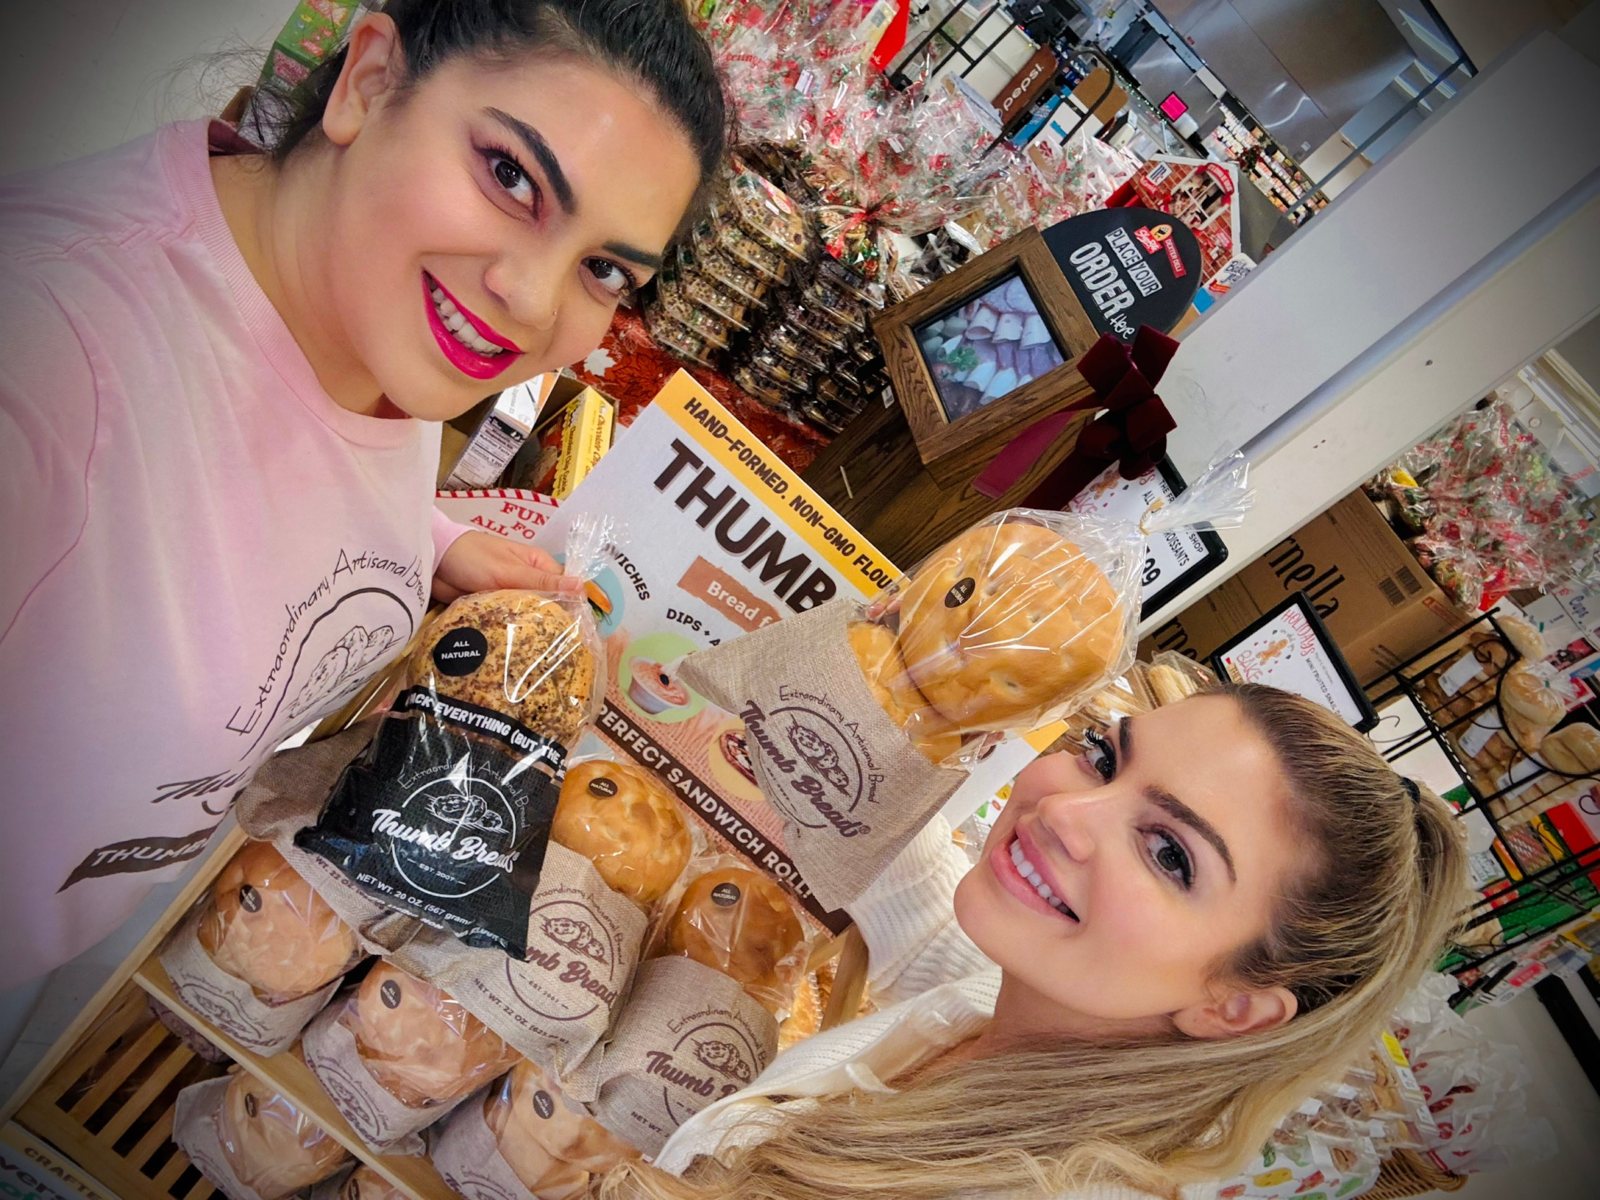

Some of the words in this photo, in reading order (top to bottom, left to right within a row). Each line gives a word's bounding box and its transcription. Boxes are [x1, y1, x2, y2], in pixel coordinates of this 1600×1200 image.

[1069, 241, 1134, 319] ORDER
[1107, 229, 1140, 267] PLACE
[1131, 261, 1159, 296] YOUR
[1110, 313, 1135, 339] Here
[684, 397, 792, 499] HAND-FORMED.
[789, 495, 857, 557] NON-GMO
[470, 515, 508, 536] ALL
[500, 501, 550, 526] FUN
[653, 437, 837, 614] THUMB
[1189, 532, 1204, 553] SHOP
[666, 608, 702, 632] DIPS
[706, 581, 760, 621] Bread
[225, 576, 331, 736] Extraordinary
[332, 548, 418, 585] Artisanal
[441, 650, 481, 660] NATURAL
[453, 640, 470, 648] ALL
[779, 684, 845, 724] Extraordinary
[433, 701, 512, 737] EVERYTHING
[510, 729, 538, 752] (BUT
[739, 699, 798, 775] Thumb
[372, 808, 452, 852] Thumb
[667, 768, 765, 854] SANDWICH
[762, 854, 812, 899] ROLL!
[356, 873, 377, 888] NET
[377, 881, 394, 896] WT.
[393, 890, 407, 902] 20
[407, 896, 424, 909] OZ.
[424, 903, 444, 917] (567
[474, 977, 489, 994] NET
[488, 993, 503, 1008] WT.
[503, 1006, 515, 1017] 22
[646, 1050, 715, 1097] Thumb
[631, 1111, 648, 1125] NET
